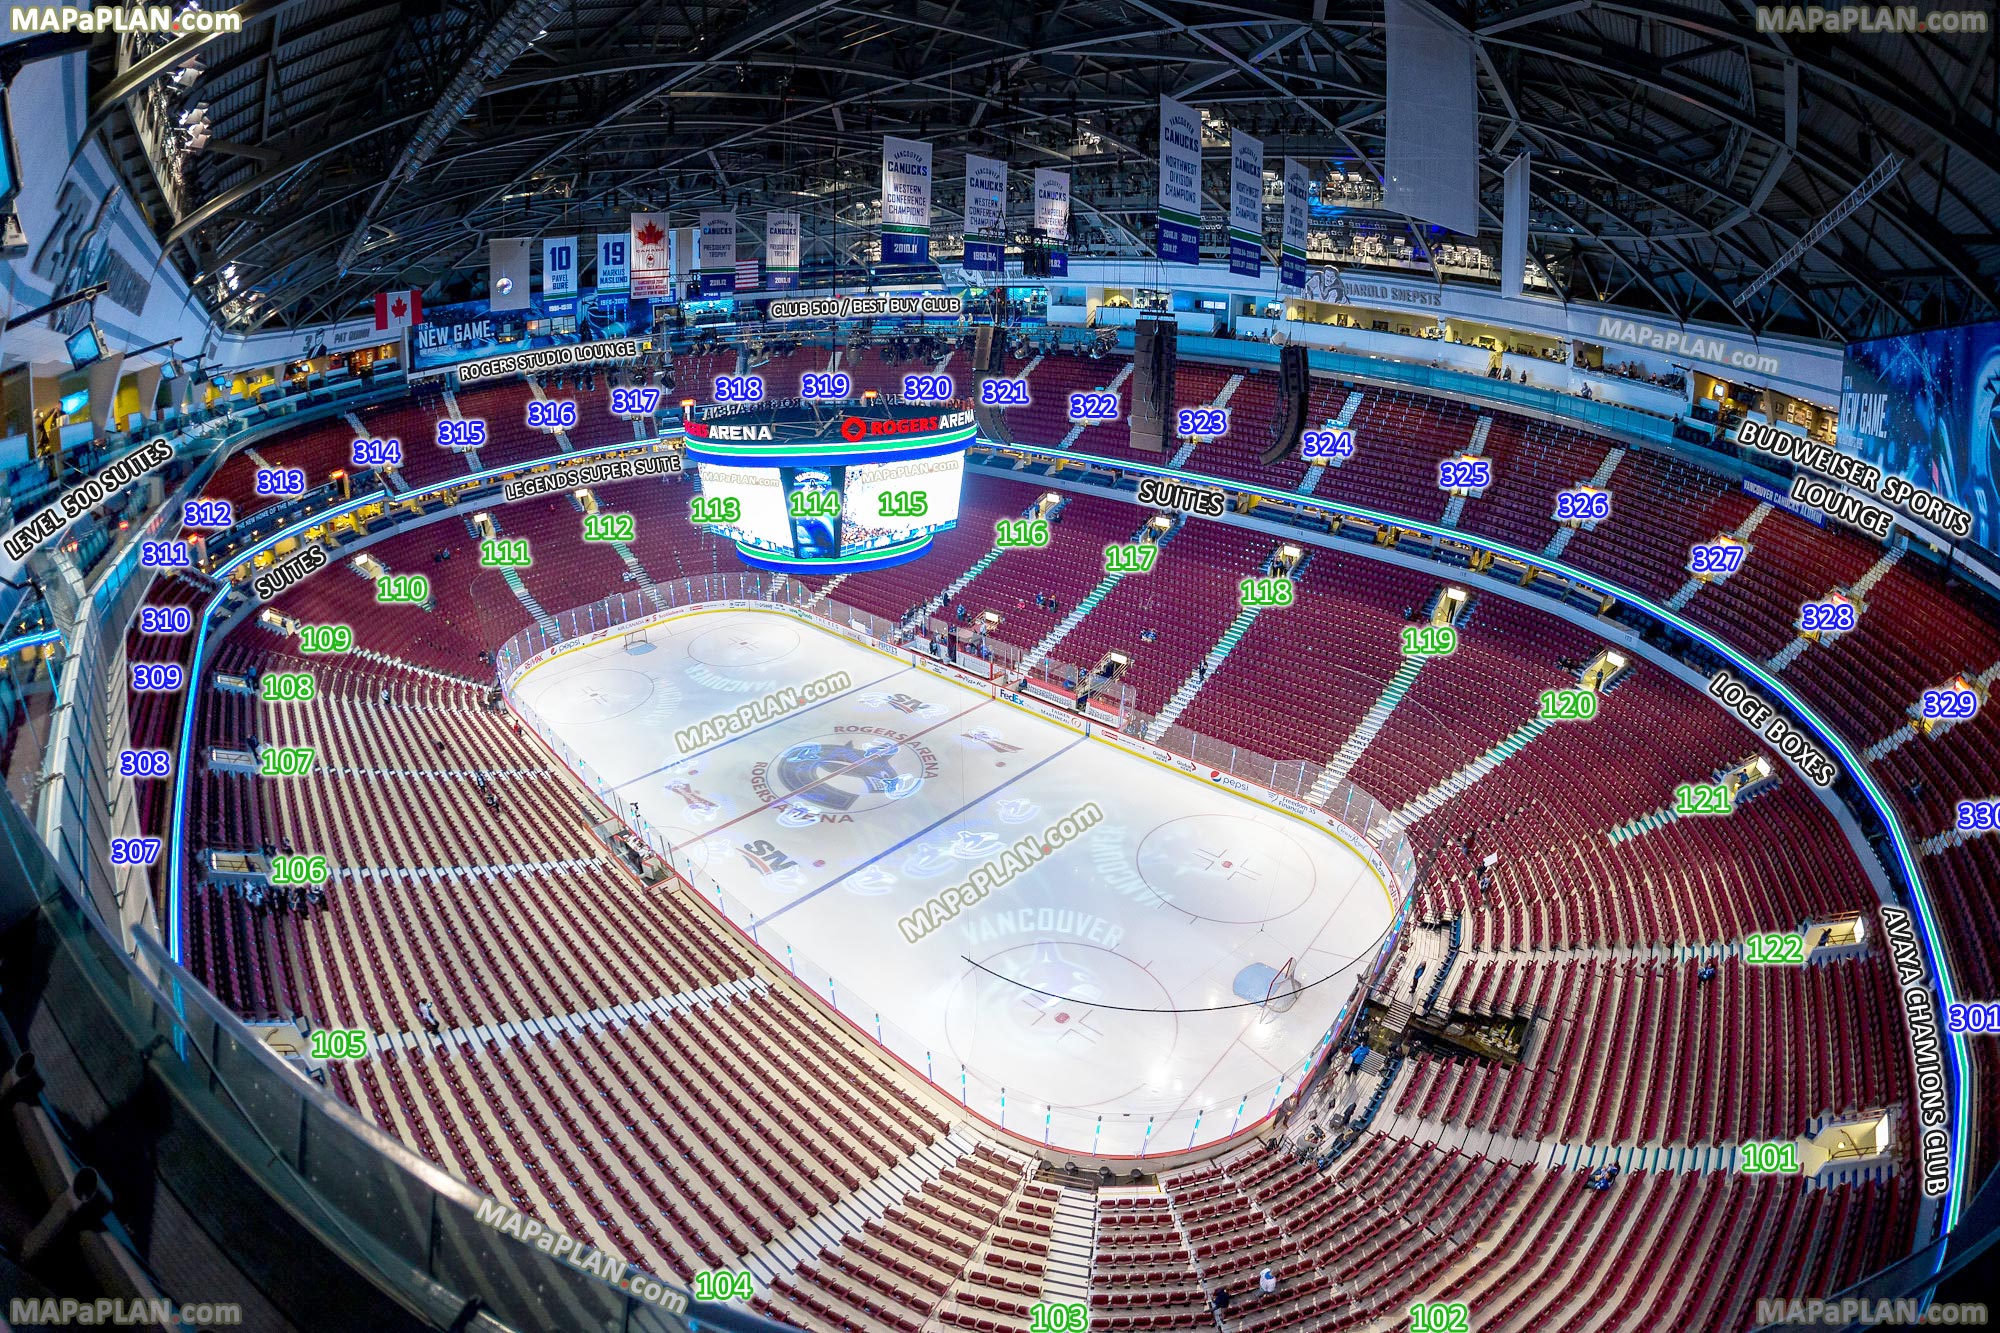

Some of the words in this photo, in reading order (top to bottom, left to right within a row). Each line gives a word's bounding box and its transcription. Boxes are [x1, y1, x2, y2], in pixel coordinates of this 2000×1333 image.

[1164, 127, 1199, 152] CANUCKS
[894, 151, 922, 162] VANCOUVER
[1165, 154, 1197, 174] NORTHWEST
[887, 161, 927, 177] CANUCKS
[1235, 157, 1261, 179] CANUCKS
[969, 177, 1003, 192] CANUCKS
[1169, 170, 1192, 187] DIVISION
[893, 183, 922, 195] WESTERN
[1038, 189, 1067, 202] CANUCKS
[1165, 183, 1196, 204] CHAMPIONS
[887, 193, 926, 207] CONFERENCE
[974, 197, 998, 208] WESTERN
[888, 204, 924, 217] CHAMPIONS
[703, 227, 732, 236] CANUCKS
[769, 227, 797, 236] CANUCKS
[550, 246, 571, 271] 10
[602, 241, 625, 266] 19
[551, 274, 568, 283] PAVEL
[600, 276, 628, 285] NASLUND
[602, 269, 625, 277] MARKUS
[552, 282, 569, 290] BURE
[1344, 283, 1388, 299] HAROLD
[1390, 287, 1441, 306] SNEPSTS
[333, 332, 349, 344] PAT
[418, 326, 449, 349] NEW
[453, 319, 495, 343] GAME.
[871, 416, 938, 435] ROGERS
[939, 409, 975, 430] ARENA
[1840, 392, 1860, 431] NEW
[1860, 392, 1888, 439] GAME.
[709, 425, 772, 441] ARENA
[1743, 479, 1774, 500] VANCOUVER
[1773, 492, 1799, 513] CANUCKS
[236, 522, 246, 531] THE
[625, 619, 645, 630] CANADA
[558, 637, 581, 652] pepsi
[1000, 688, 1025, 707] FedEx
[1051, 708, 1071, 720] FASKEN
[834, 725, 908, 741] ROGERS
[907, 740, 938, 779] ARENA
[1153, 751, 1168, 761] Global
[1176, 760, 1192, 770] Global
[751, 761, 779, 803] ROGERS
[1222, 776, 1249, 792] pepsi
[1279, 800, 1304, 815] Financial
[1283, 797, 1308, 811] Freedom
[959, 907, 1125, 949] VANCOUVER
